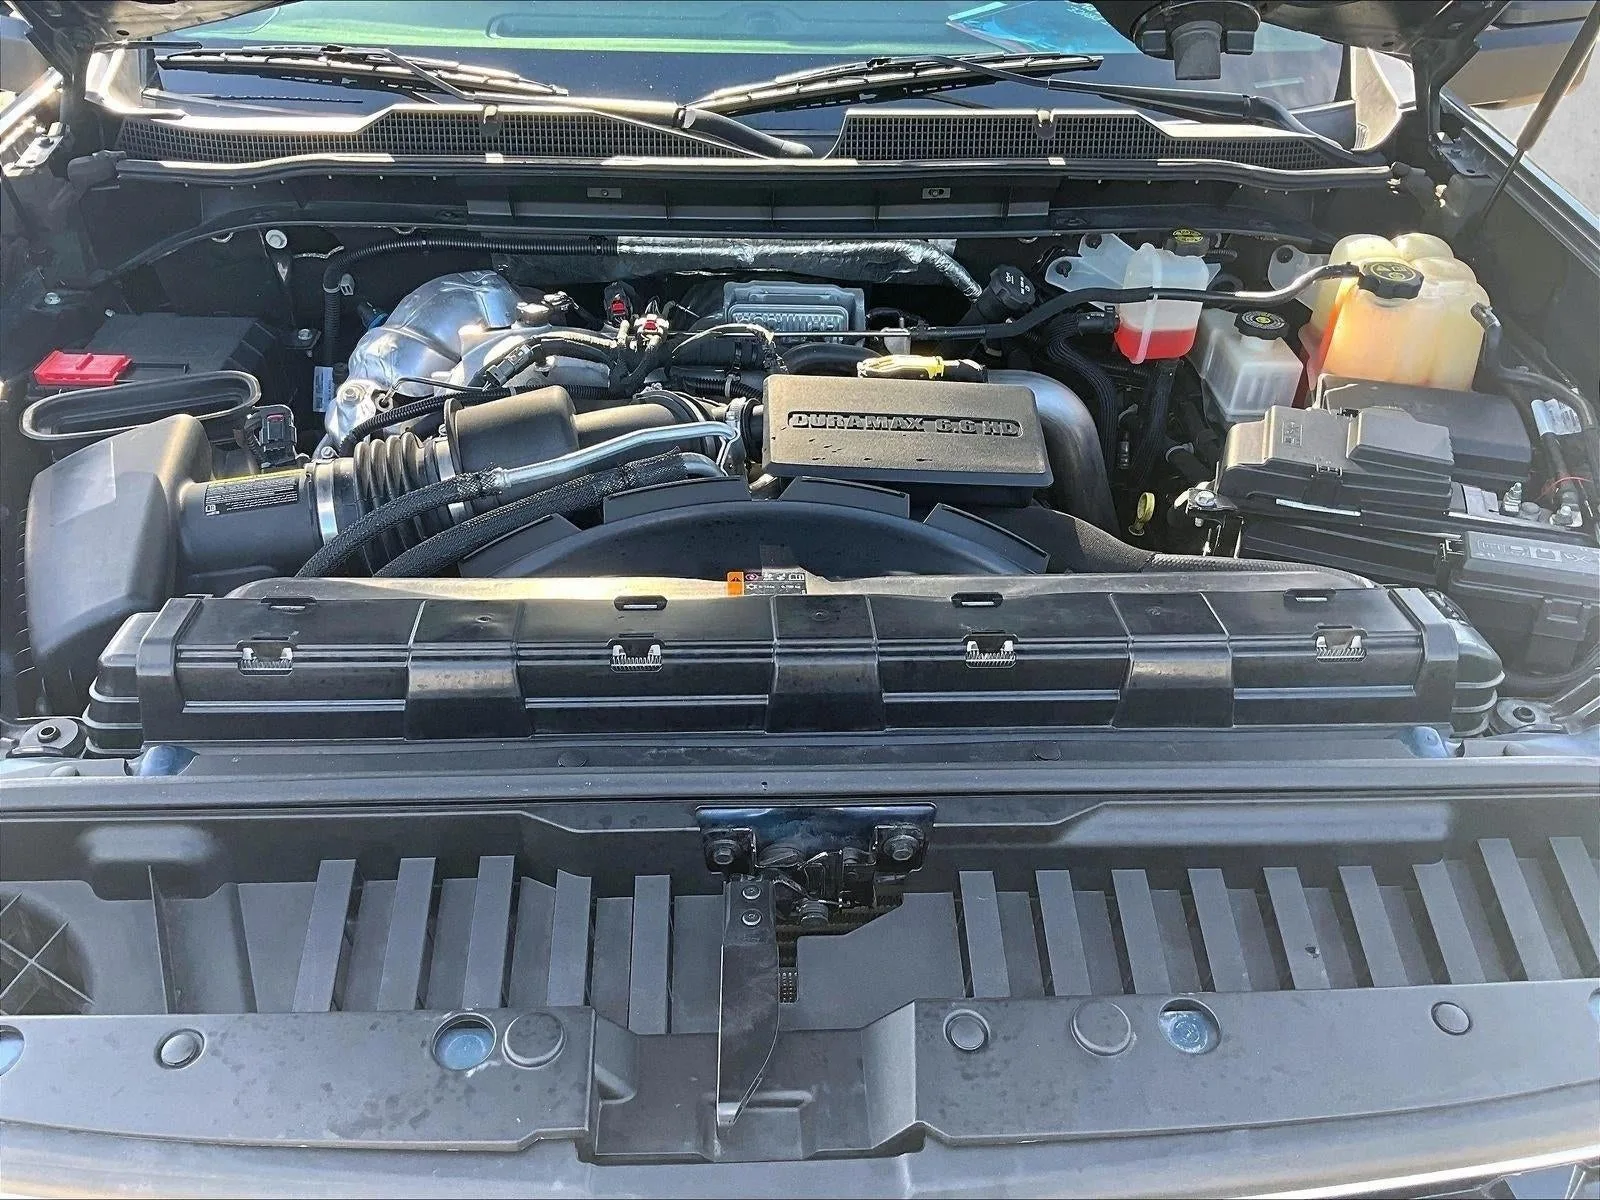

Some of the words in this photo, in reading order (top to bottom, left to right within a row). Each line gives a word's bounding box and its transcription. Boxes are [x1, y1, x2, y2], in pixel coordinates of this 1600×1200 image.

[789, 413, 925, 432] DURAMAX
[935, 418, 977, 434] 6.6
[982, 421, 1020, 436] HD
